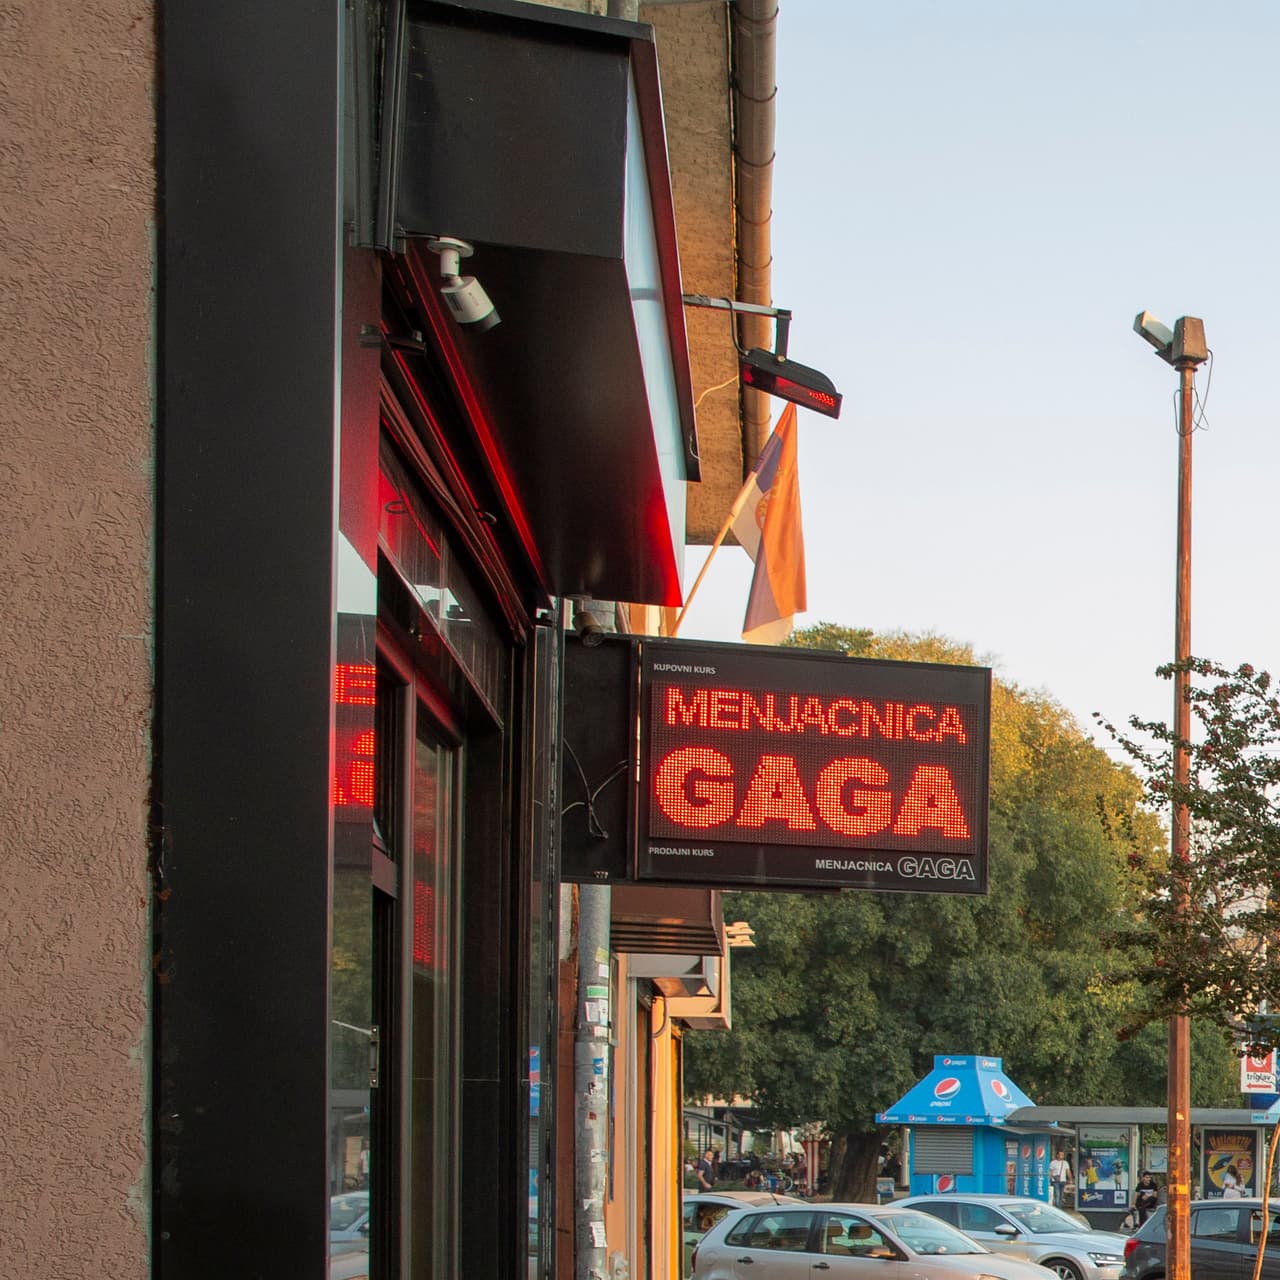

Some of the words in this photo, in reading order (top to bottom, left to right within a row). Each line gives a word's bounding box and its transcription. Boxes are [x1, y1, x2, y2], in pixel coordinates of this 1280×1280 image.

[653, 662, 692, 674] KUPOVNI
[694, 665, 716, 675] KURS
[665, 686, 968, 745] MENJACNICA
[655, 746, 971, 839] GAGA
[648, 846, 690, 857] PRODAJNI
[691, 848, 715, 858] KURS
[815, 859, 894, 873] MENJACNICA
[896, 856, 976, 881] GAGA
